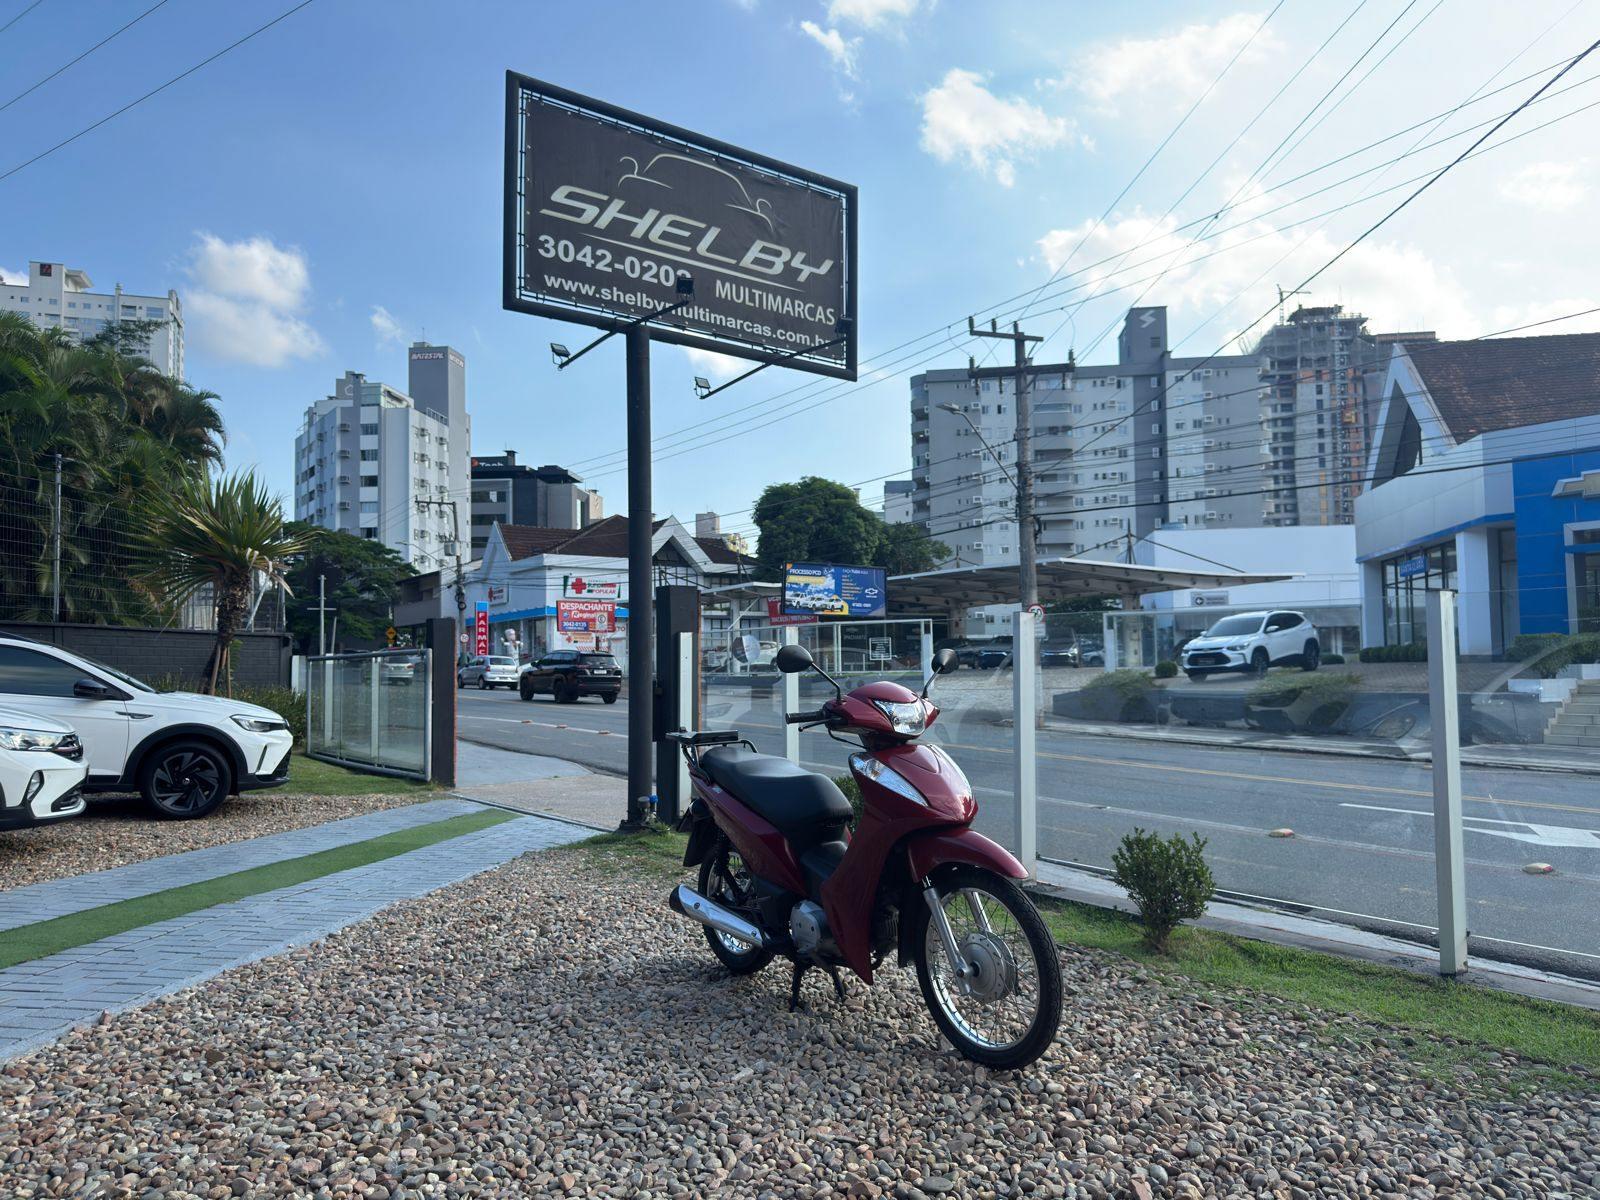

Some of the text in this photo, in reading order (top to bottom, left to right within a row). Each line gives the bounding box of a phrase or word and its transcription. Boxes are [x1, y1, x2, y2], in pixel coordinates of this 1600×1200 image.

[539, 185, 835, 283] SHELBY
[715, 279, 836, 326] MULTIMARCAS
[560, 602, 614, 612] DESPACHANTE
